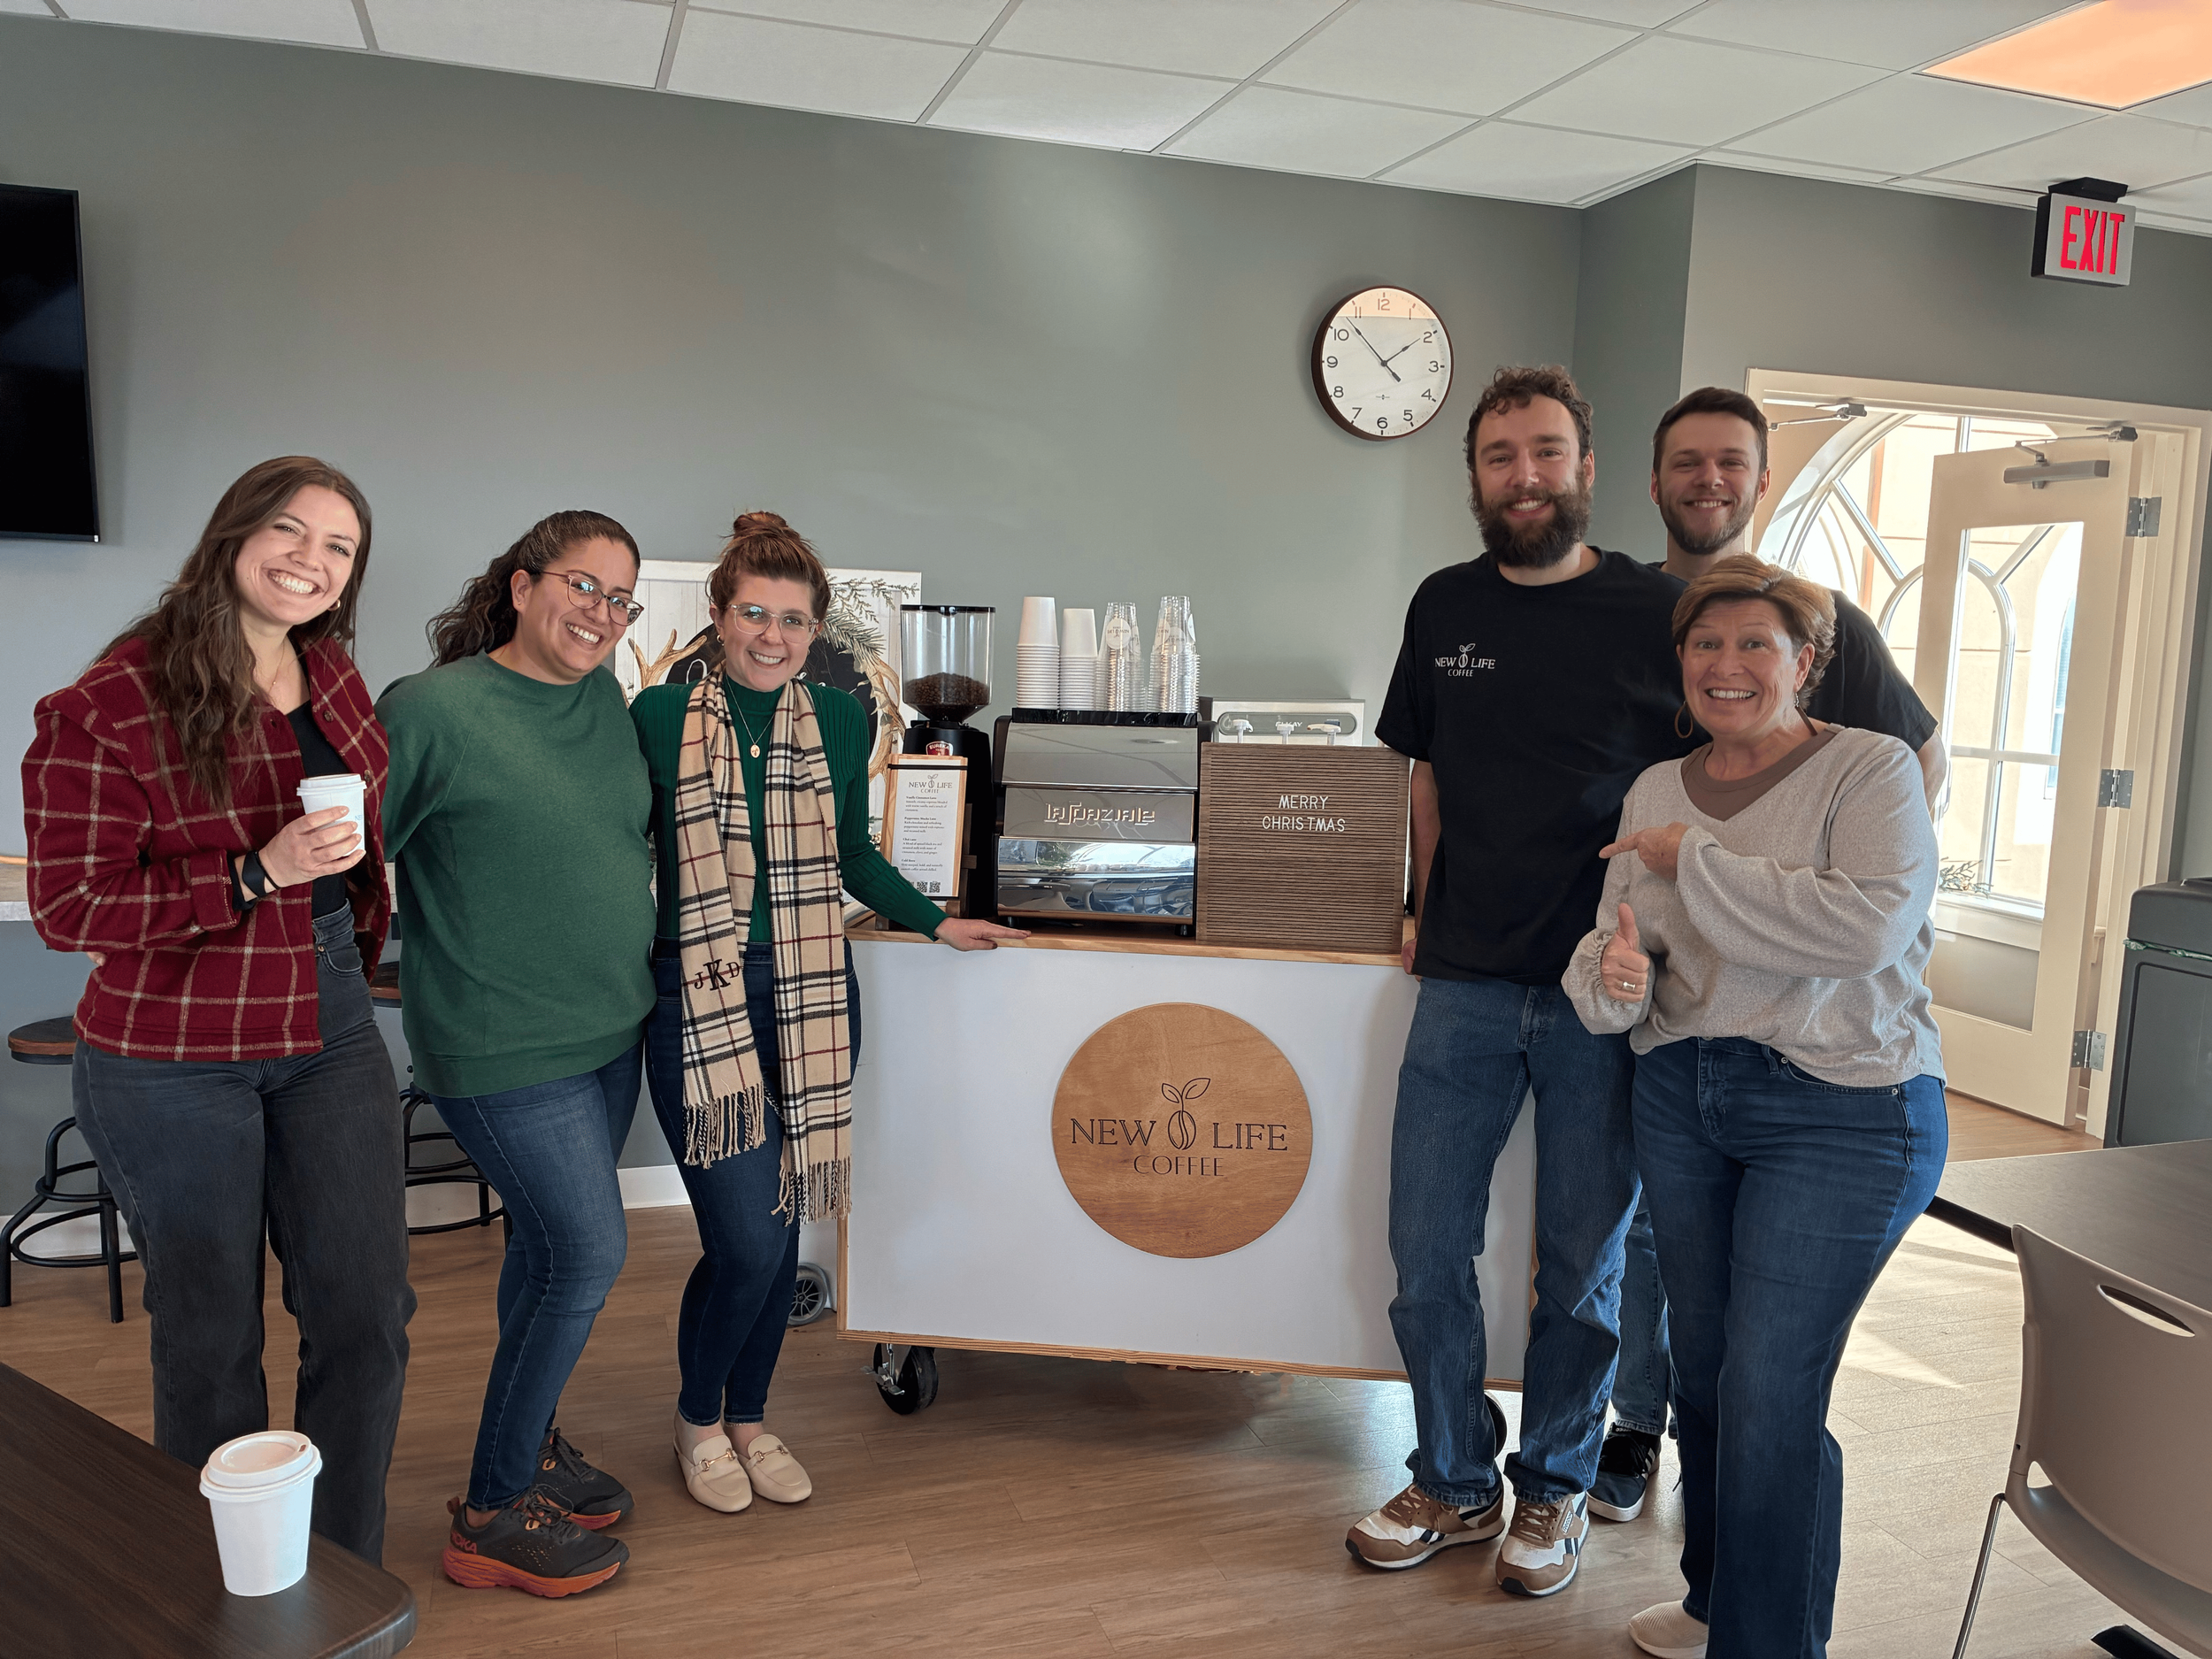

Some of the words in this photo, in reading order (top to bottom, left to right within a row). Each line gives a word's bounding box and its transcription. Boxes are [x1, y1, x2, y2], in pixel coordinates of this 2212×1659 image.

[2060, 205, 2125, 275] EXIT
[1378, 298, 1390, 311] 12
[1355, 306, 1362, 319] 11
[1333, 328, 1349, 342] 10
[1423, 331, 1432, 343] 2
[1326, 356, 1339, 368] 9
[1428, 360, 1440, 373] 3
[1333, 386, 1344, 398] 8
[1421, 388, 1432, 401] 4
[1352, 407, 1363, 419] 7
[1403, 410, 1413, 422] 5
[1377, 417, 1388, 429] 6
[1434, 657, 1457, 667] NEW
[1471, 657, 1496, 669] LIFE
[1448, 668, 1474, 677] COFFEE
[1279, 795, 1329, 810] MERRY
[1262, 815, 1346, 832] CHRISTMAS
[1071, 1118, 1156, 1146] NEW
[1212, 1122, 1288, 1151] LIFE
[1133, 1155, 1225, 1177] COFFEE
